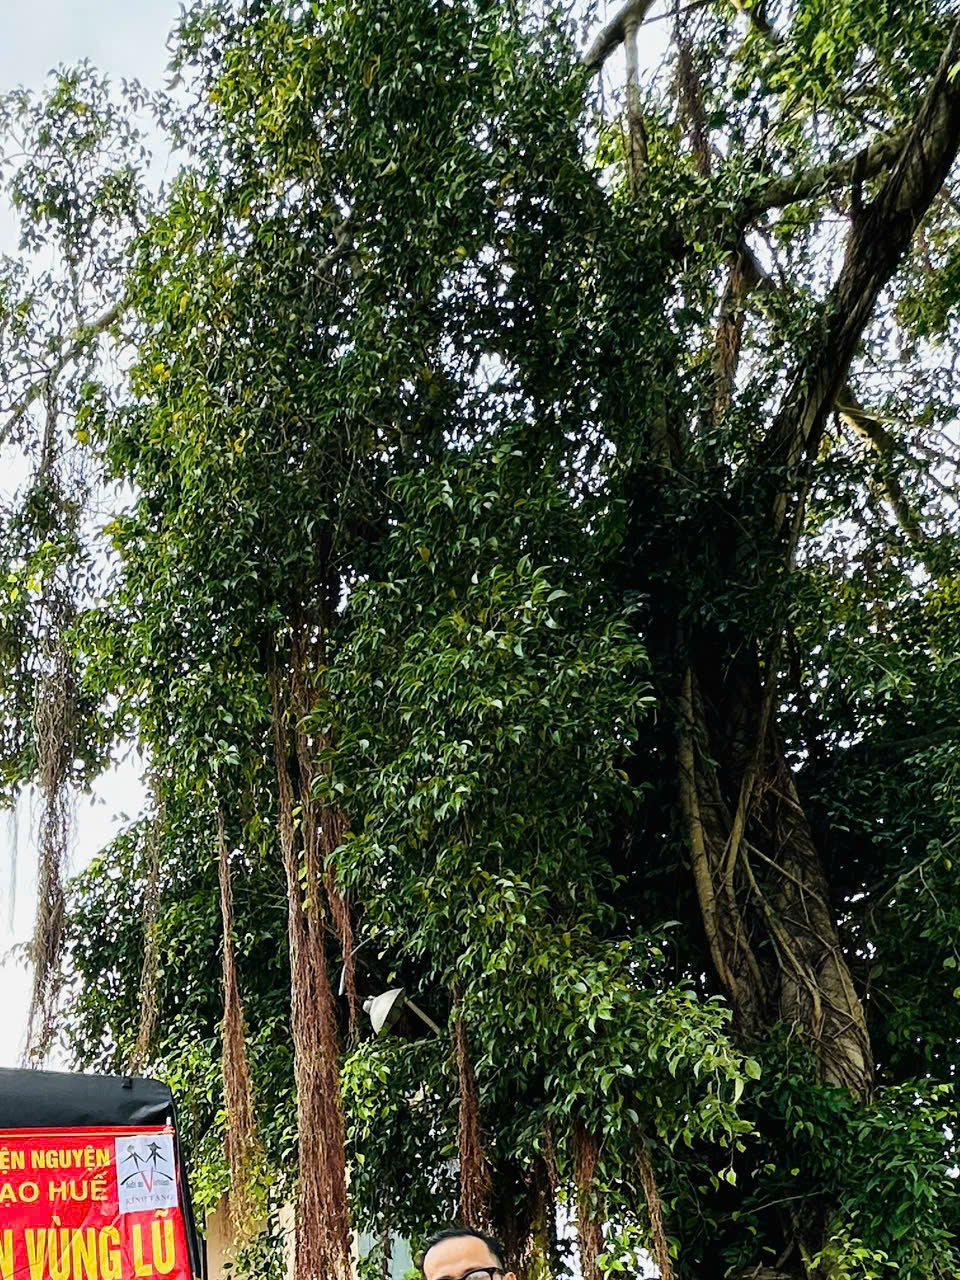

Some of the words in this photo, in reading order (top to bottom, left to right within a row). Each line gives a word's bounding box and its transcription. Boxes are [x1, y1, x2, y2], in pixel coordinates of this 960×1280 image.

[31, 1145, 110, 1171] NGUYỆN
[48, 1171, 108, 1202] HUẾ
[132, 1209, 177, 1278] LŨ
